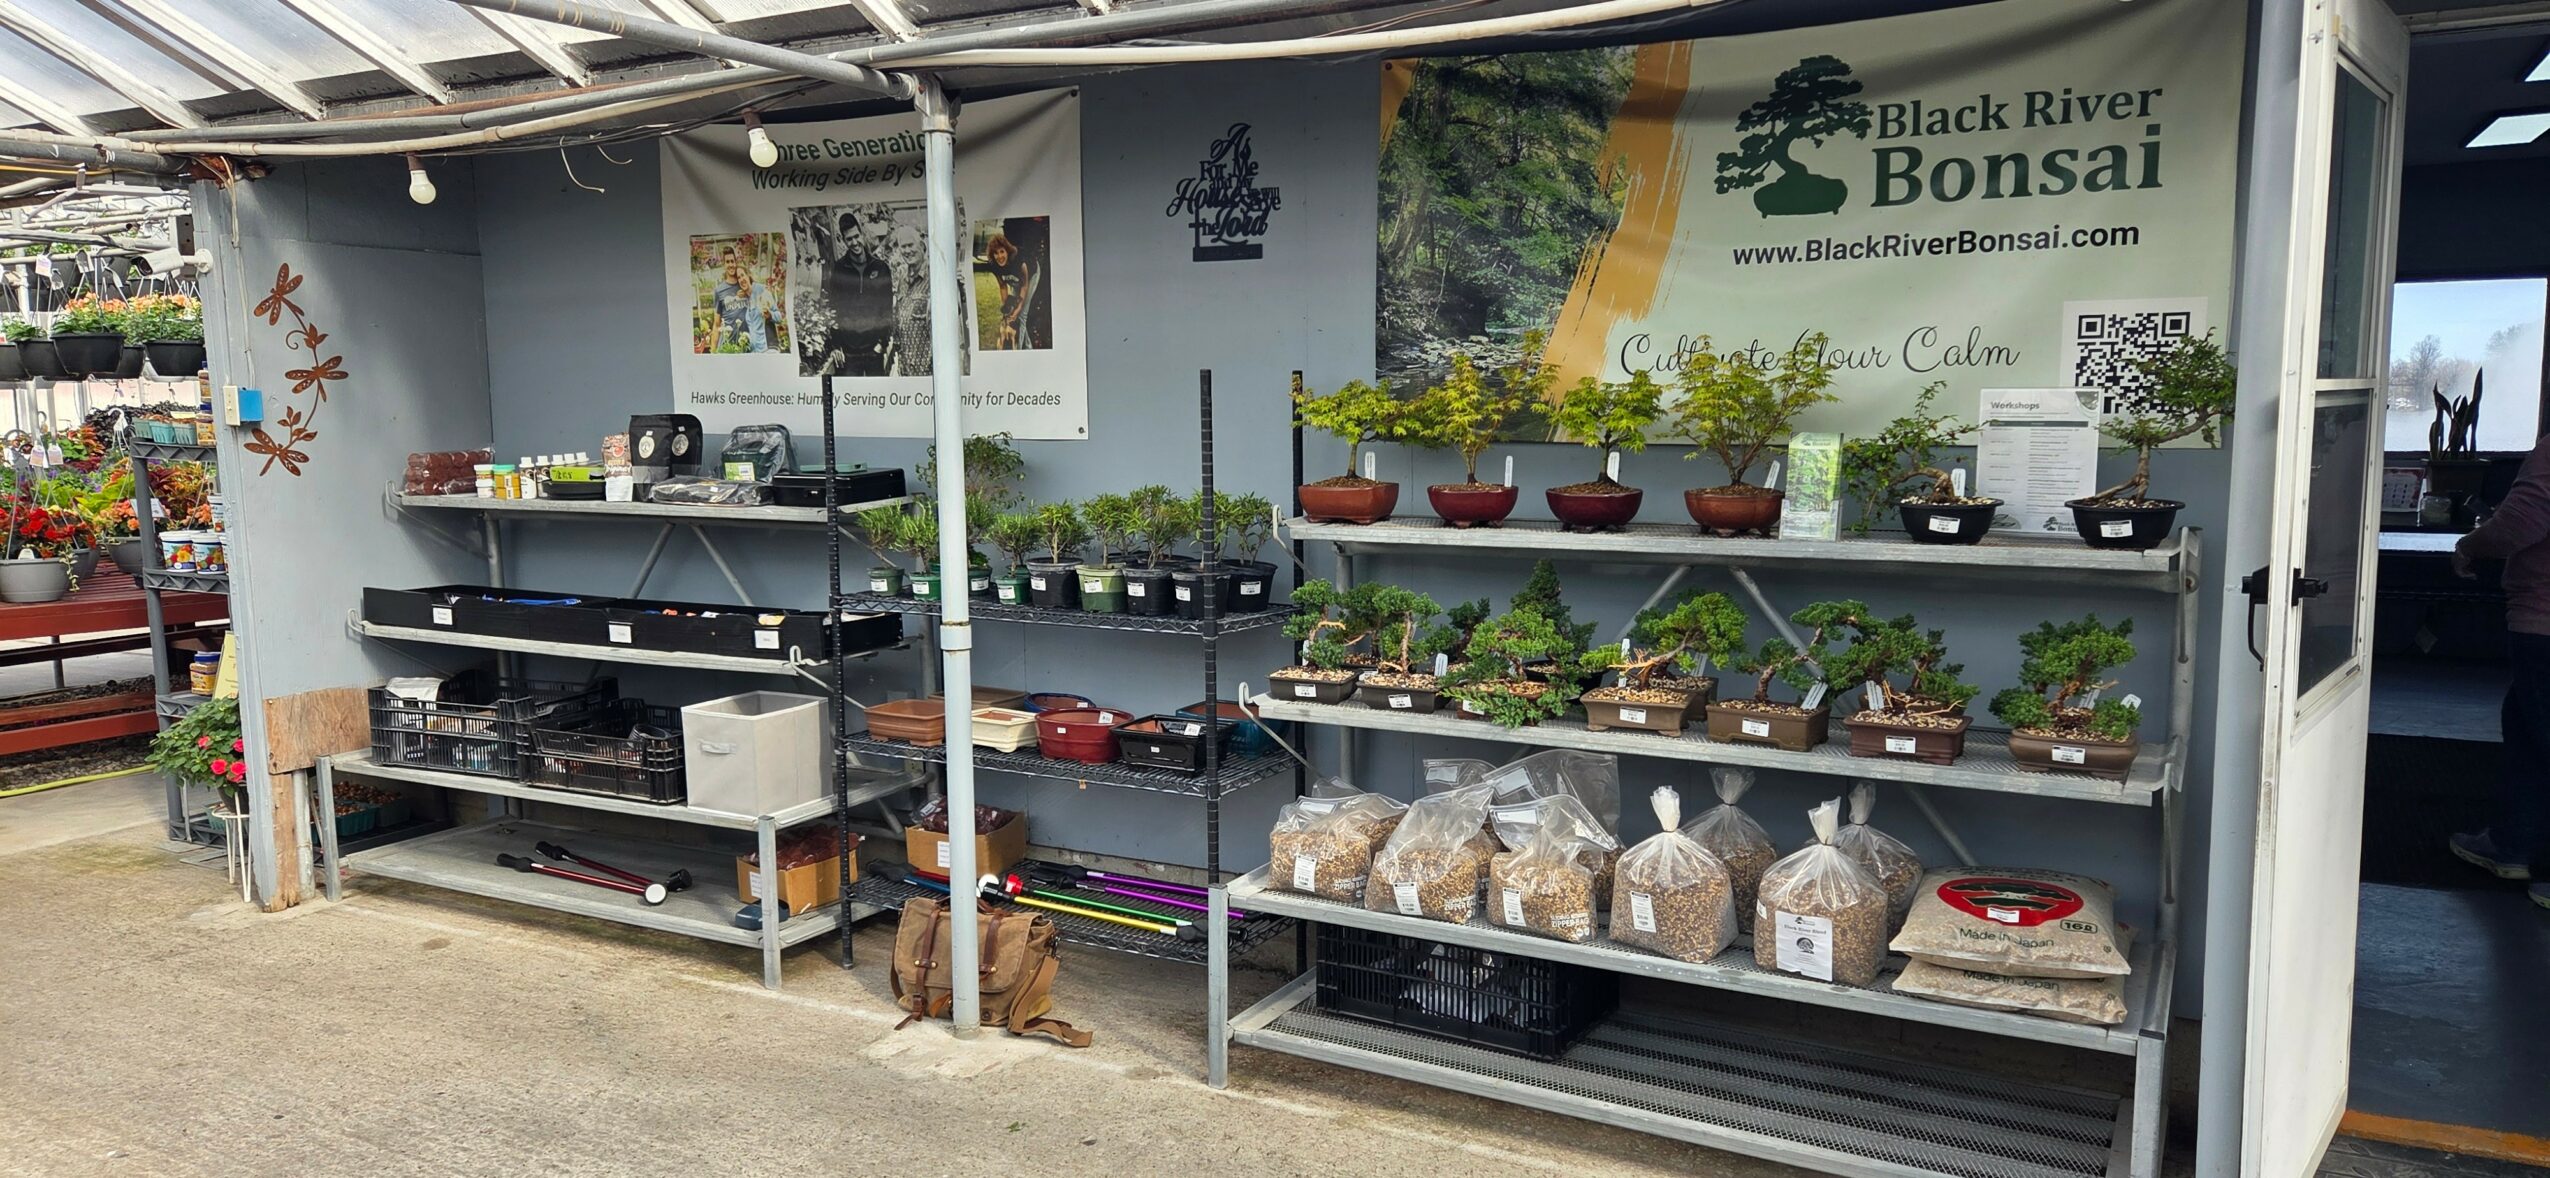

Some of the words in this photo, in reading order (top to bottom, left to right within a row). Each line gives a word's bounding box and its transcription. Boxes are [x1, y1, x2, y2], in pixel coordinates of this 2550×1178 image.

[1876, 94, 2010, 139] Black
[2022, 88, 2163, 128] River
[771, 140, 821, 161] hree
[1210, 122, 1252, 163] As
[752, 167, 829, 191] Working
[834, 164, 881, 185] Side
[881, 161, 907, 185] By
[1199, 160, 1228, 181] For
[1232, 158, 1259, 177] Me
[1870, 123, 2163, 207] Bonsai
[1210, 206, 1268, 246] Lord
[1732, 224, 2140, 265] www.BlackRiverBonsai.com
[1903, 325, 2021, 373] Calm
[691, 392, 726, 404] Hawks
[728, 392, 794, 405] Greenhouse:
[797, 392, 841, 409] Humy
[843, 392, 886, 409] Serving
[890, 392, 911, 405] Our
[914, 392, 982, 409] Conity
[986, 391, 1004, 405] for
[1007, 391, 1061, 405] Decades
[1991, 401, 2040, 410] Workshops
[1960, 928, 1996, 940] Made
[2014, 936, 2055, 948] Japan
[1963, 970, 2000, 983] Made
[2018, 979, 2060, 991] Japan
